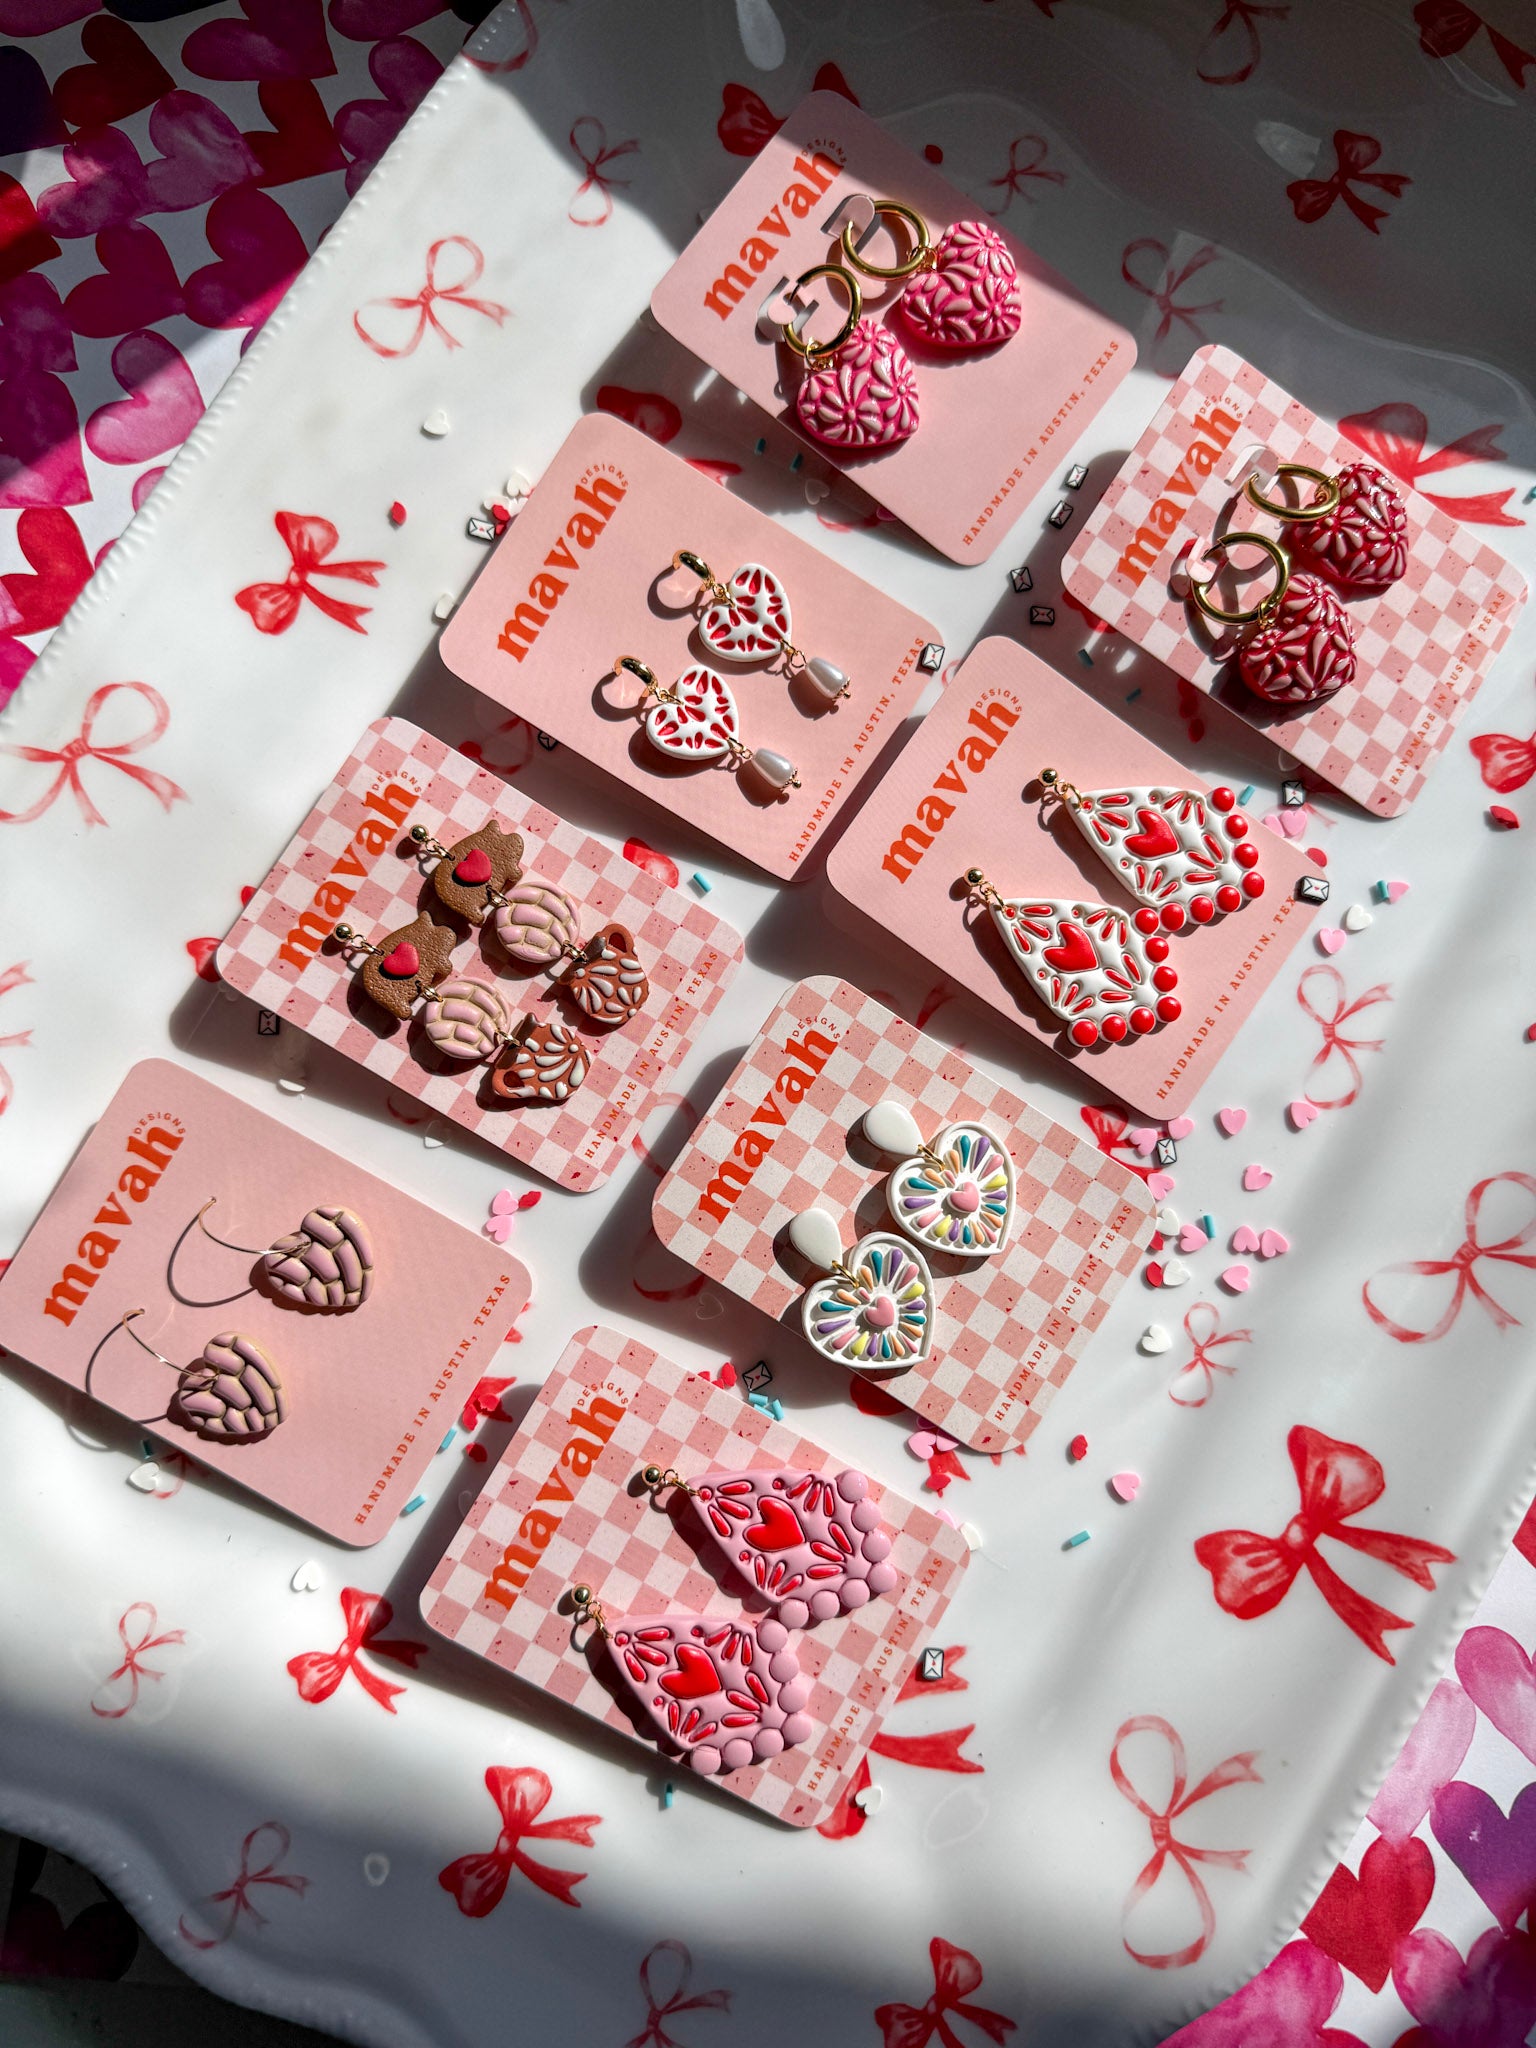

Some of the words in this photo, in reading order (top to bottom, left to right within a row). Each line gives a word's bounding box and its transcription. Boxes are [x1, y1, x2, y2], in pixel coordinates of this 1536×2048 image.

[704, 153, 844, 321] mavah
[802, 139, 847, 163] DESIGNS
[581, 464, 629, 488] DESIGNS
[963, 468, 1023, 546] HANDMADE
[1023, 448, 1038, 465] IN
[1039, 391, 1086, 445] AUSTIN,
[1083, 341, 1119, 385] TEXAS
[1118, 408, 1242, 588] mavah
[1200, 395, 1243, 419] DESIGNS
[497, 477, 627, 663] mavah
[372, 770, 422, 793] DESIGNS
[789, 780, 842, 862] HANDMADE
[840, 757, 855, 774] IN
[854, 694, 895, 752] AUSTIN,
[892, 638, 924, 684] TEXAS
[976, 688, 1022, 712] DESIGNS
[1390, 713, 1436, 785] HANDMADE
[1434, 693, 1446, 709] IN
[1446, 639, 1481, 689] AUSTIN,
[1478, 592, 1505, 632] TEXAS
[279, 784, 420, 973] mavah
[882, 702, 1020, 884] mavah
[585, 1082, 637, 1159] HANDMADE
[635, 1061, 650, 1078] IN
[650, 1002, 689, 1057] AUSTIN,
[687, 952, 718, 994] TEXAS
[792, 1016, 841, 1039] DESIGNS
[1156, 1017, 1215, 1100] HANDMADE
[1214, 994, 1230, 1012] IN
[1230, 932, 1275, 991] AUSTIN,
[1273, 895, 1296, 925] TEX
[134, 1112, 186, 1135] DESIGNS
[698, 1030, 838, 1224] mavah
[44, 1127, 184, 1327] mavah
[995, 1341, 1048, 1421] HANDMADE
[1047, 1319, 1061, 1336] IN
[1061, 1258, 1103, 1315] AUSTIN,
[1100, 1206, 1132, 1250] TEXAS
[354, 1432, 415, 1525] HANDMADE
[414, 1407, 430, 1427] IN
[430, 1335, 477, 1402] AUSTIN,
[473, 1275, 511, 1327] TEXAS
[577, 1382, 629, 1407] DESIGNS
[484, 1397, 626, 1611] mavah
[808, 1705, 860, 1792] HANDMADE
[858, 1682, 872, 1700] IN
[873, 1615, 913, 1677] AUSTIN,
[910, 1558, 942, 1607] TEXAS
